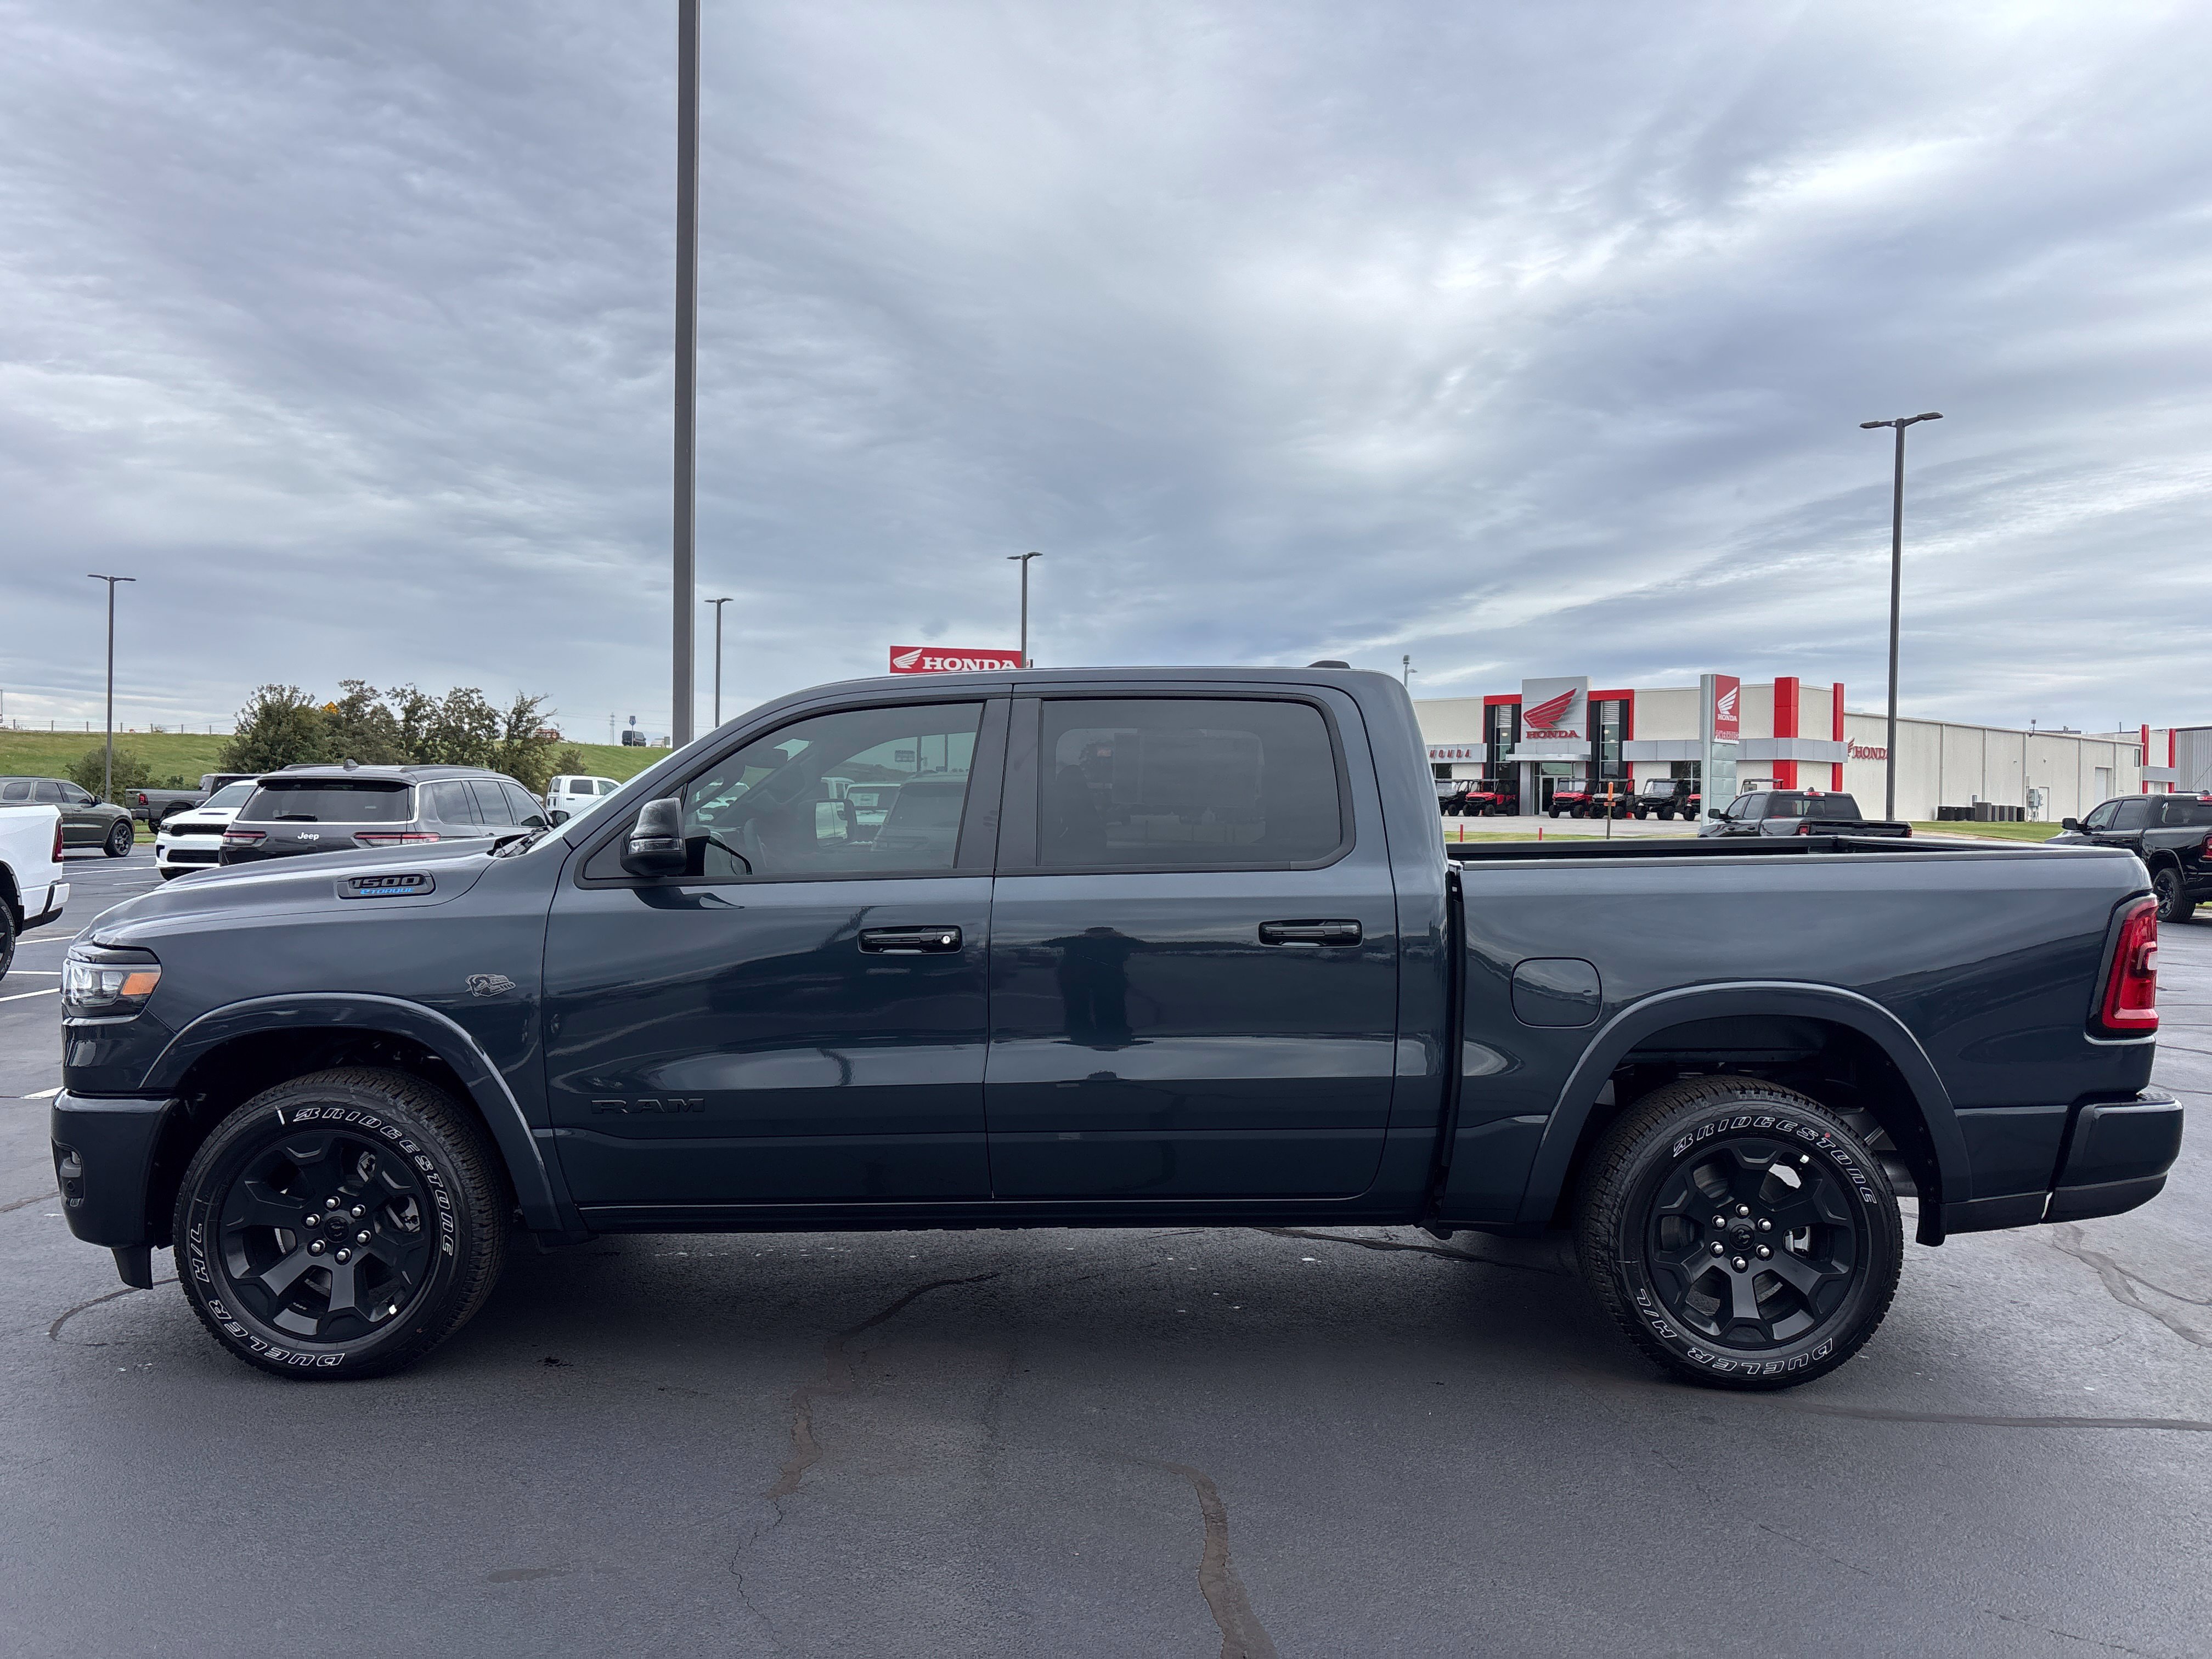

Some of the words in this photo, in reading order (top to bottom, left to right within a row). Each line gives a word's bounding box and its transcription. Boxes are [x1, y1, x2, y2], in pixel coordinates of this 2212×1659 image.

[923, 657, 1015, 670] HONDA
[1718, 714, 1737, 722] HONDA
[1526, 730, 1579, 739] HONDA
[1430, 749, 1471, 758] HONDA
[1853, 746, 1887, 759] HOND
[297, 832, 319, 840] Jeep
[351, 877, 420, 888] 1500
[591, 1098, 706, 1113] RAM
[1673, 1116, 1877, 1204] BRIDGESTONE
[292, 1107, 454, 1256] BRIDGESTONE
[208, 1299, 346, 1367] DUELER
[1688, 1338, 1833, 1375] DUELER
